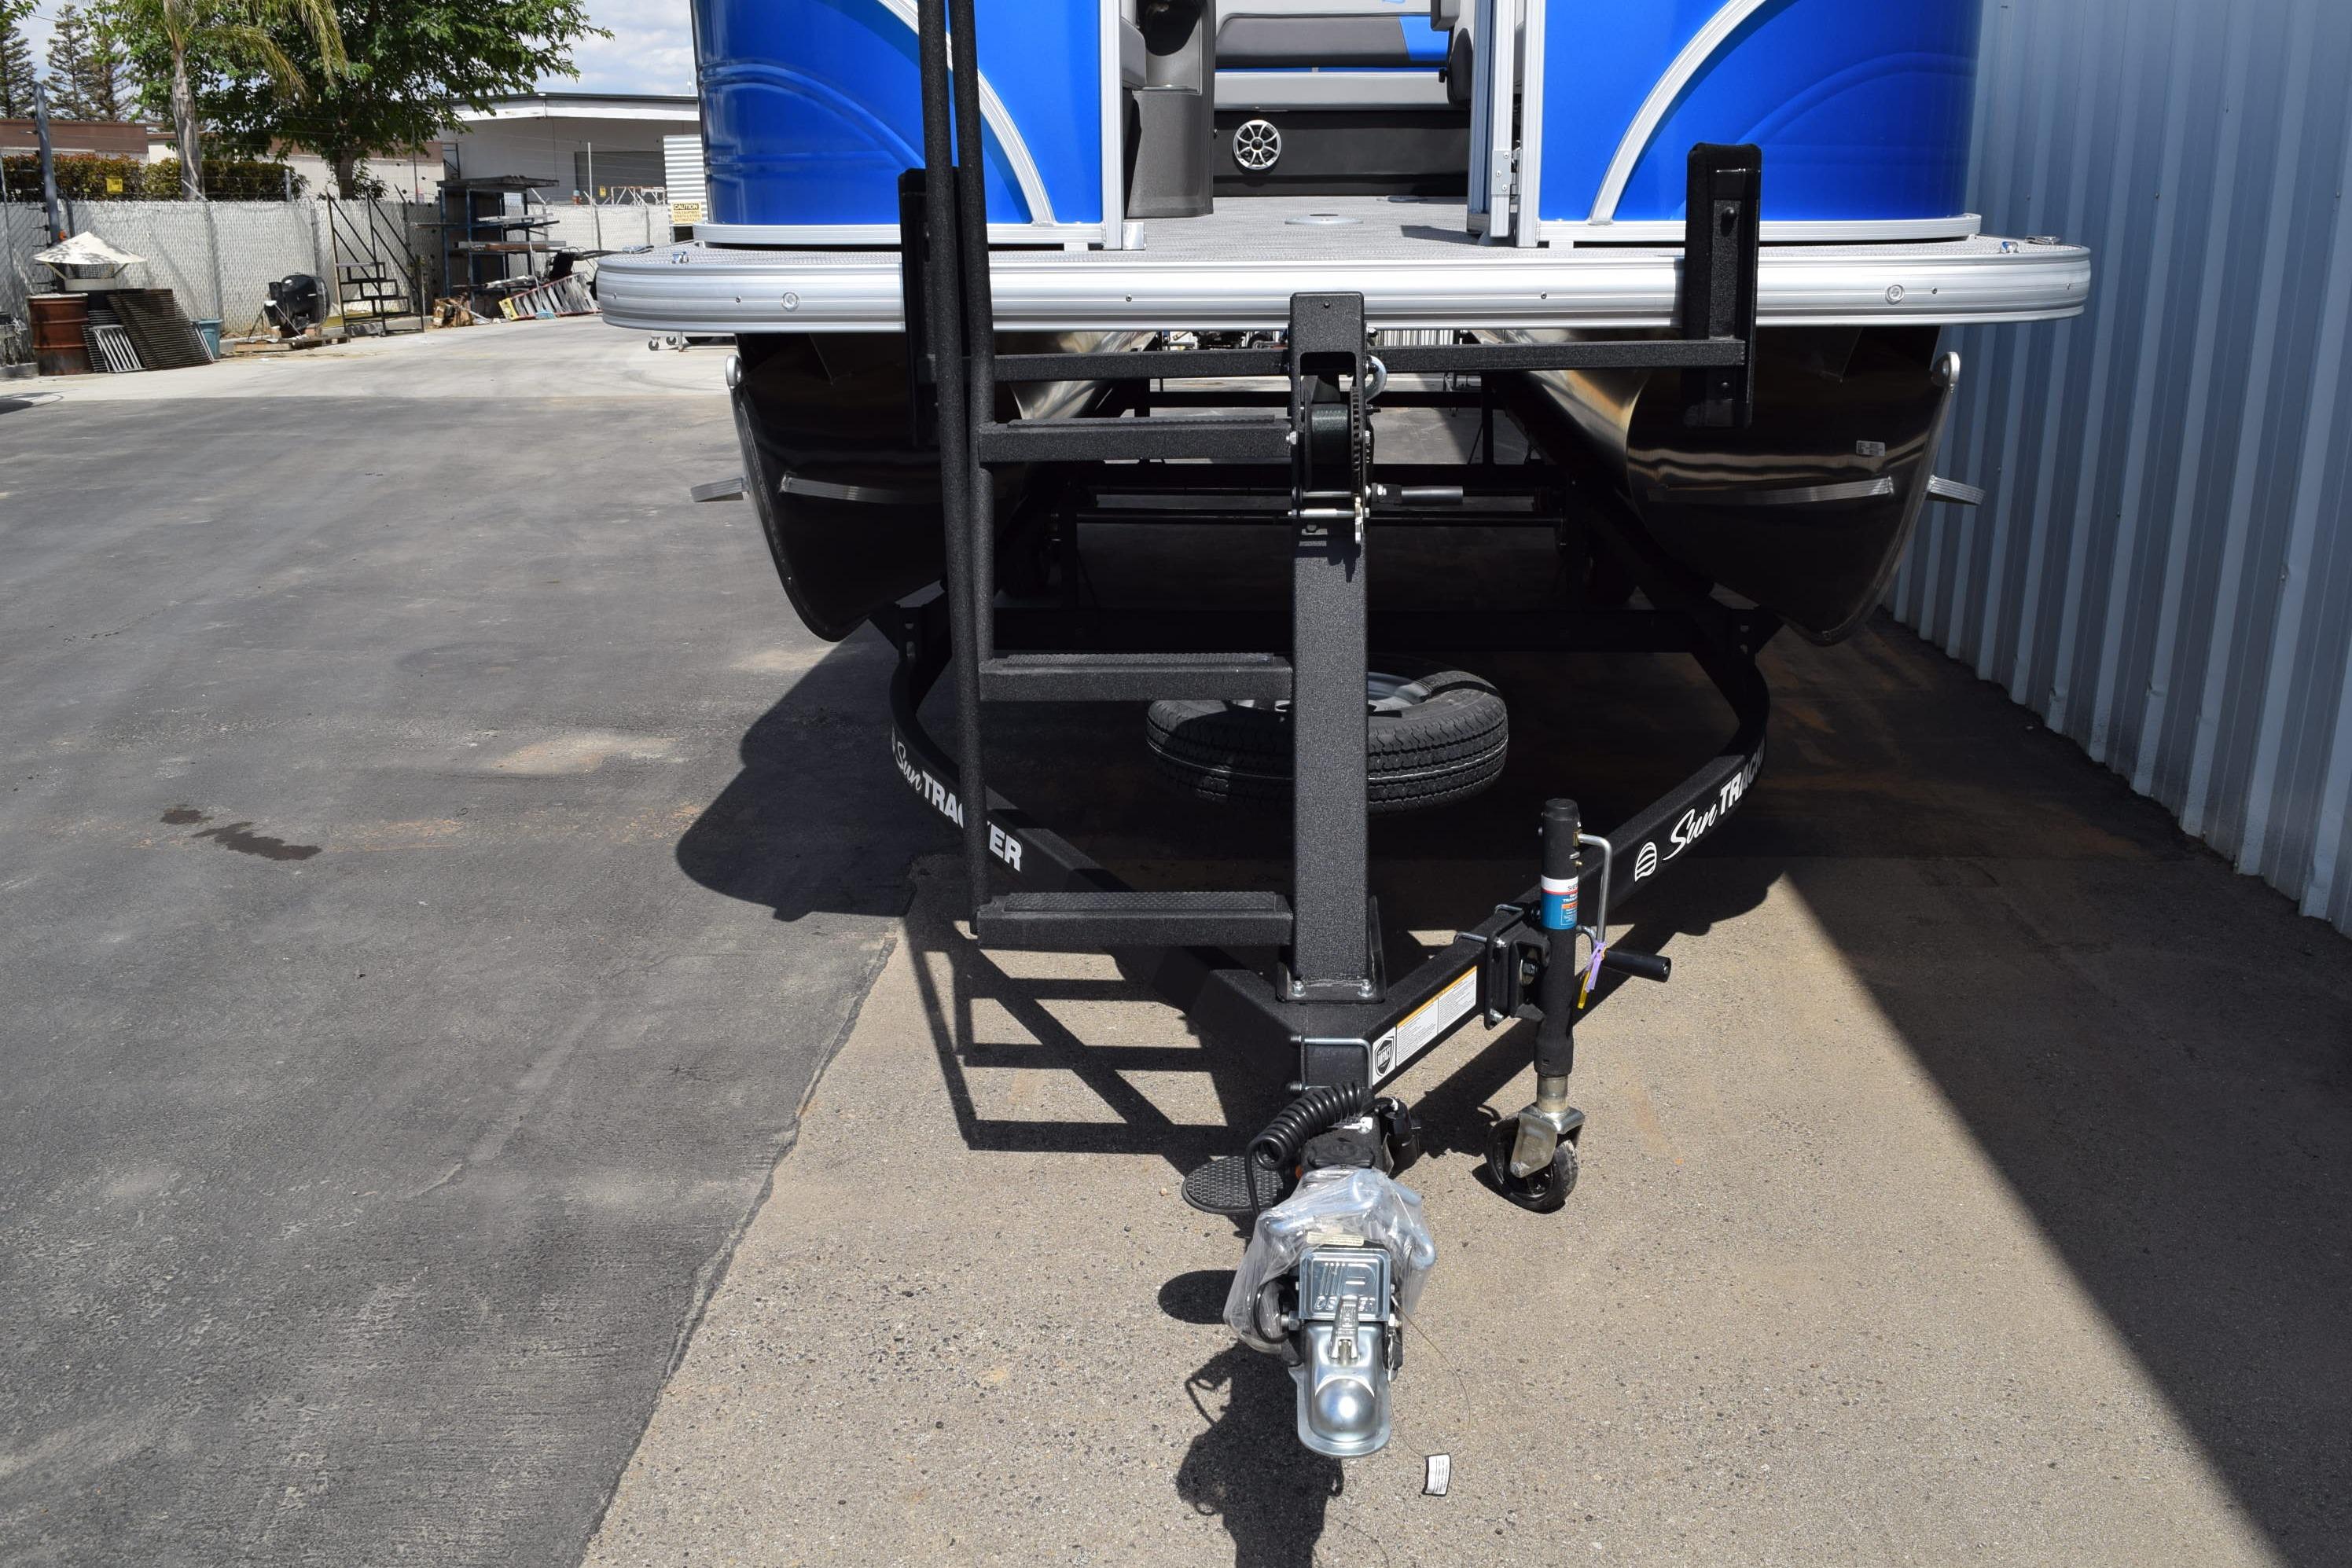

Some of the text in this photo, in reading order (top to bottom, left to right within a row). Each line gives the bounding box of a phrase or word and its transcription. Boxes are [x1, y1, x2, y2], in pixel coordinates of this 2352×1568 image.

[895, 741, 1023, 872] Sun TRAER
[1662, 803, 1718, 861] Sun
[1314, 1294, 1376, 1311] DEER
